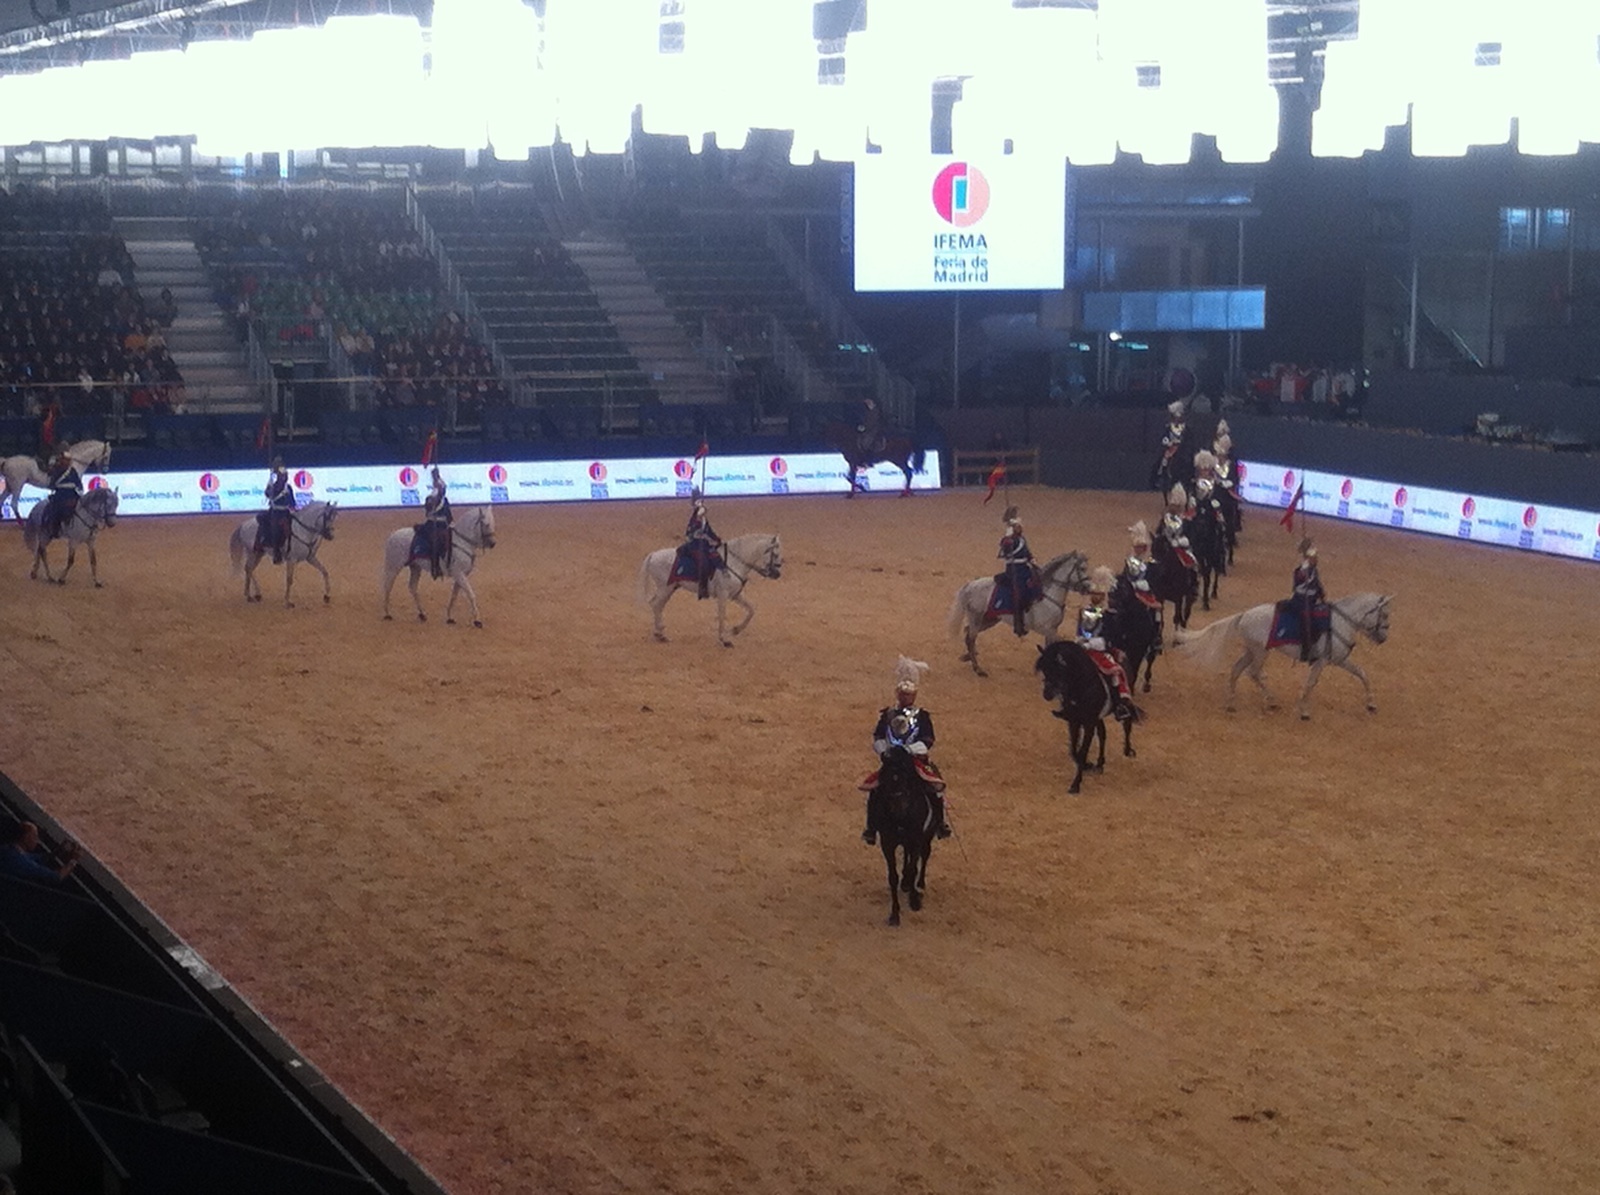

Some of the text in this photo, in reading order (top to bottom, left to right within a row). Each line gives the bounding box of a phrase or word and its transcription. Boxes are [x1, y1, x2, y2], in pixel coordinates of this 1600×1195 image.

[934, 233, 988, 249] IFEMA
[934, 256, 988, 268] Feria de
[934, 270, 988, 283] Madrid
